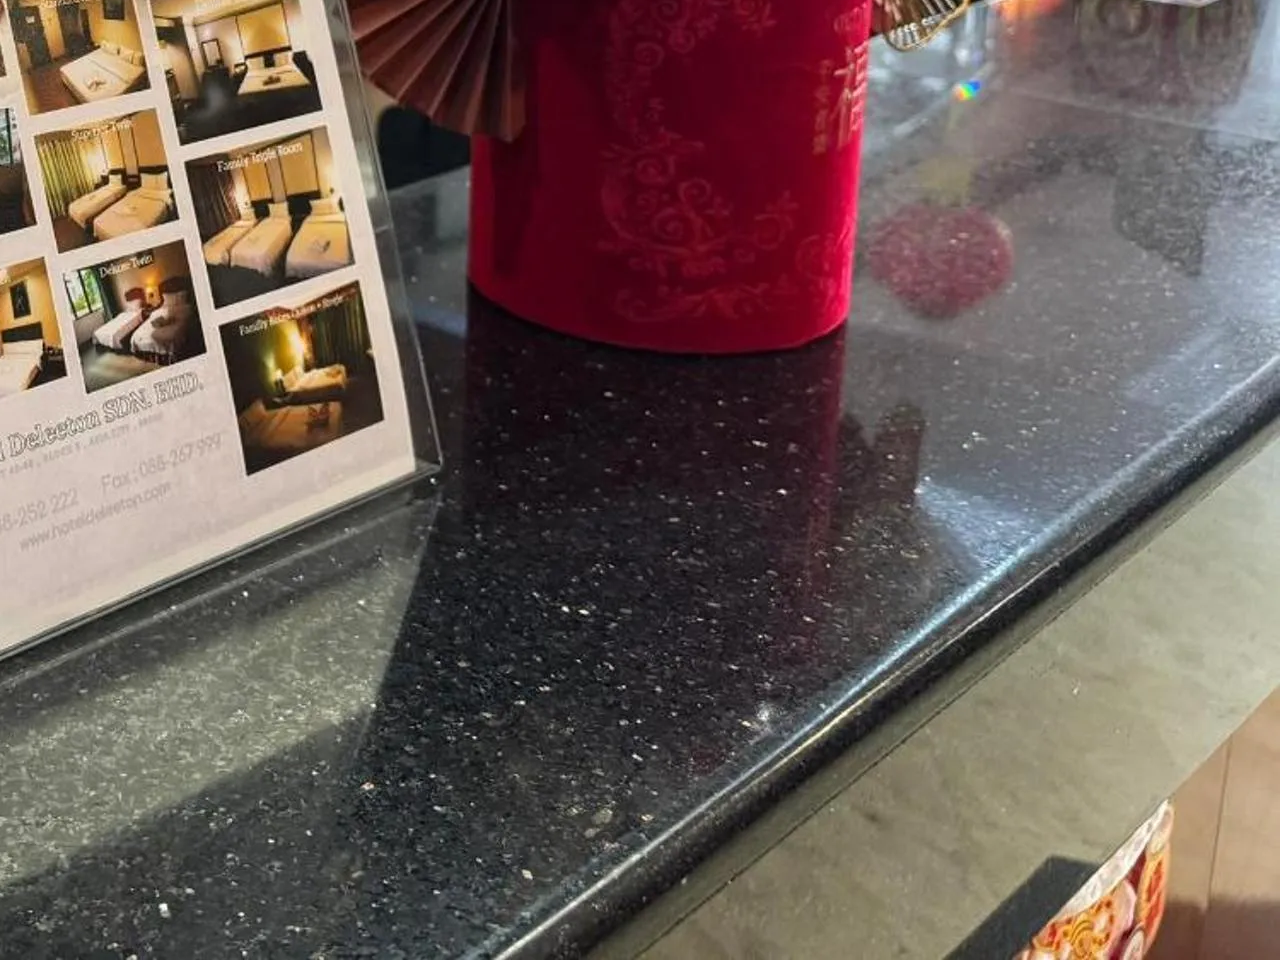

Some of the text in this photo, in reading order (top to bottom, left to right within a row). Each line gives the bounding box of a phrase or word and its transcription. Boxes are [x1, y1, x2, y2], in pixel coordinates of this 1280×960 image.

[216, 153, 249, 173] Family
[9, 409, 101, 457] Deleeton
[102, 390, 152, 425] SDN.
[153, 372, 205, 406] BHD.
[51, 488, 79, 513] 222
